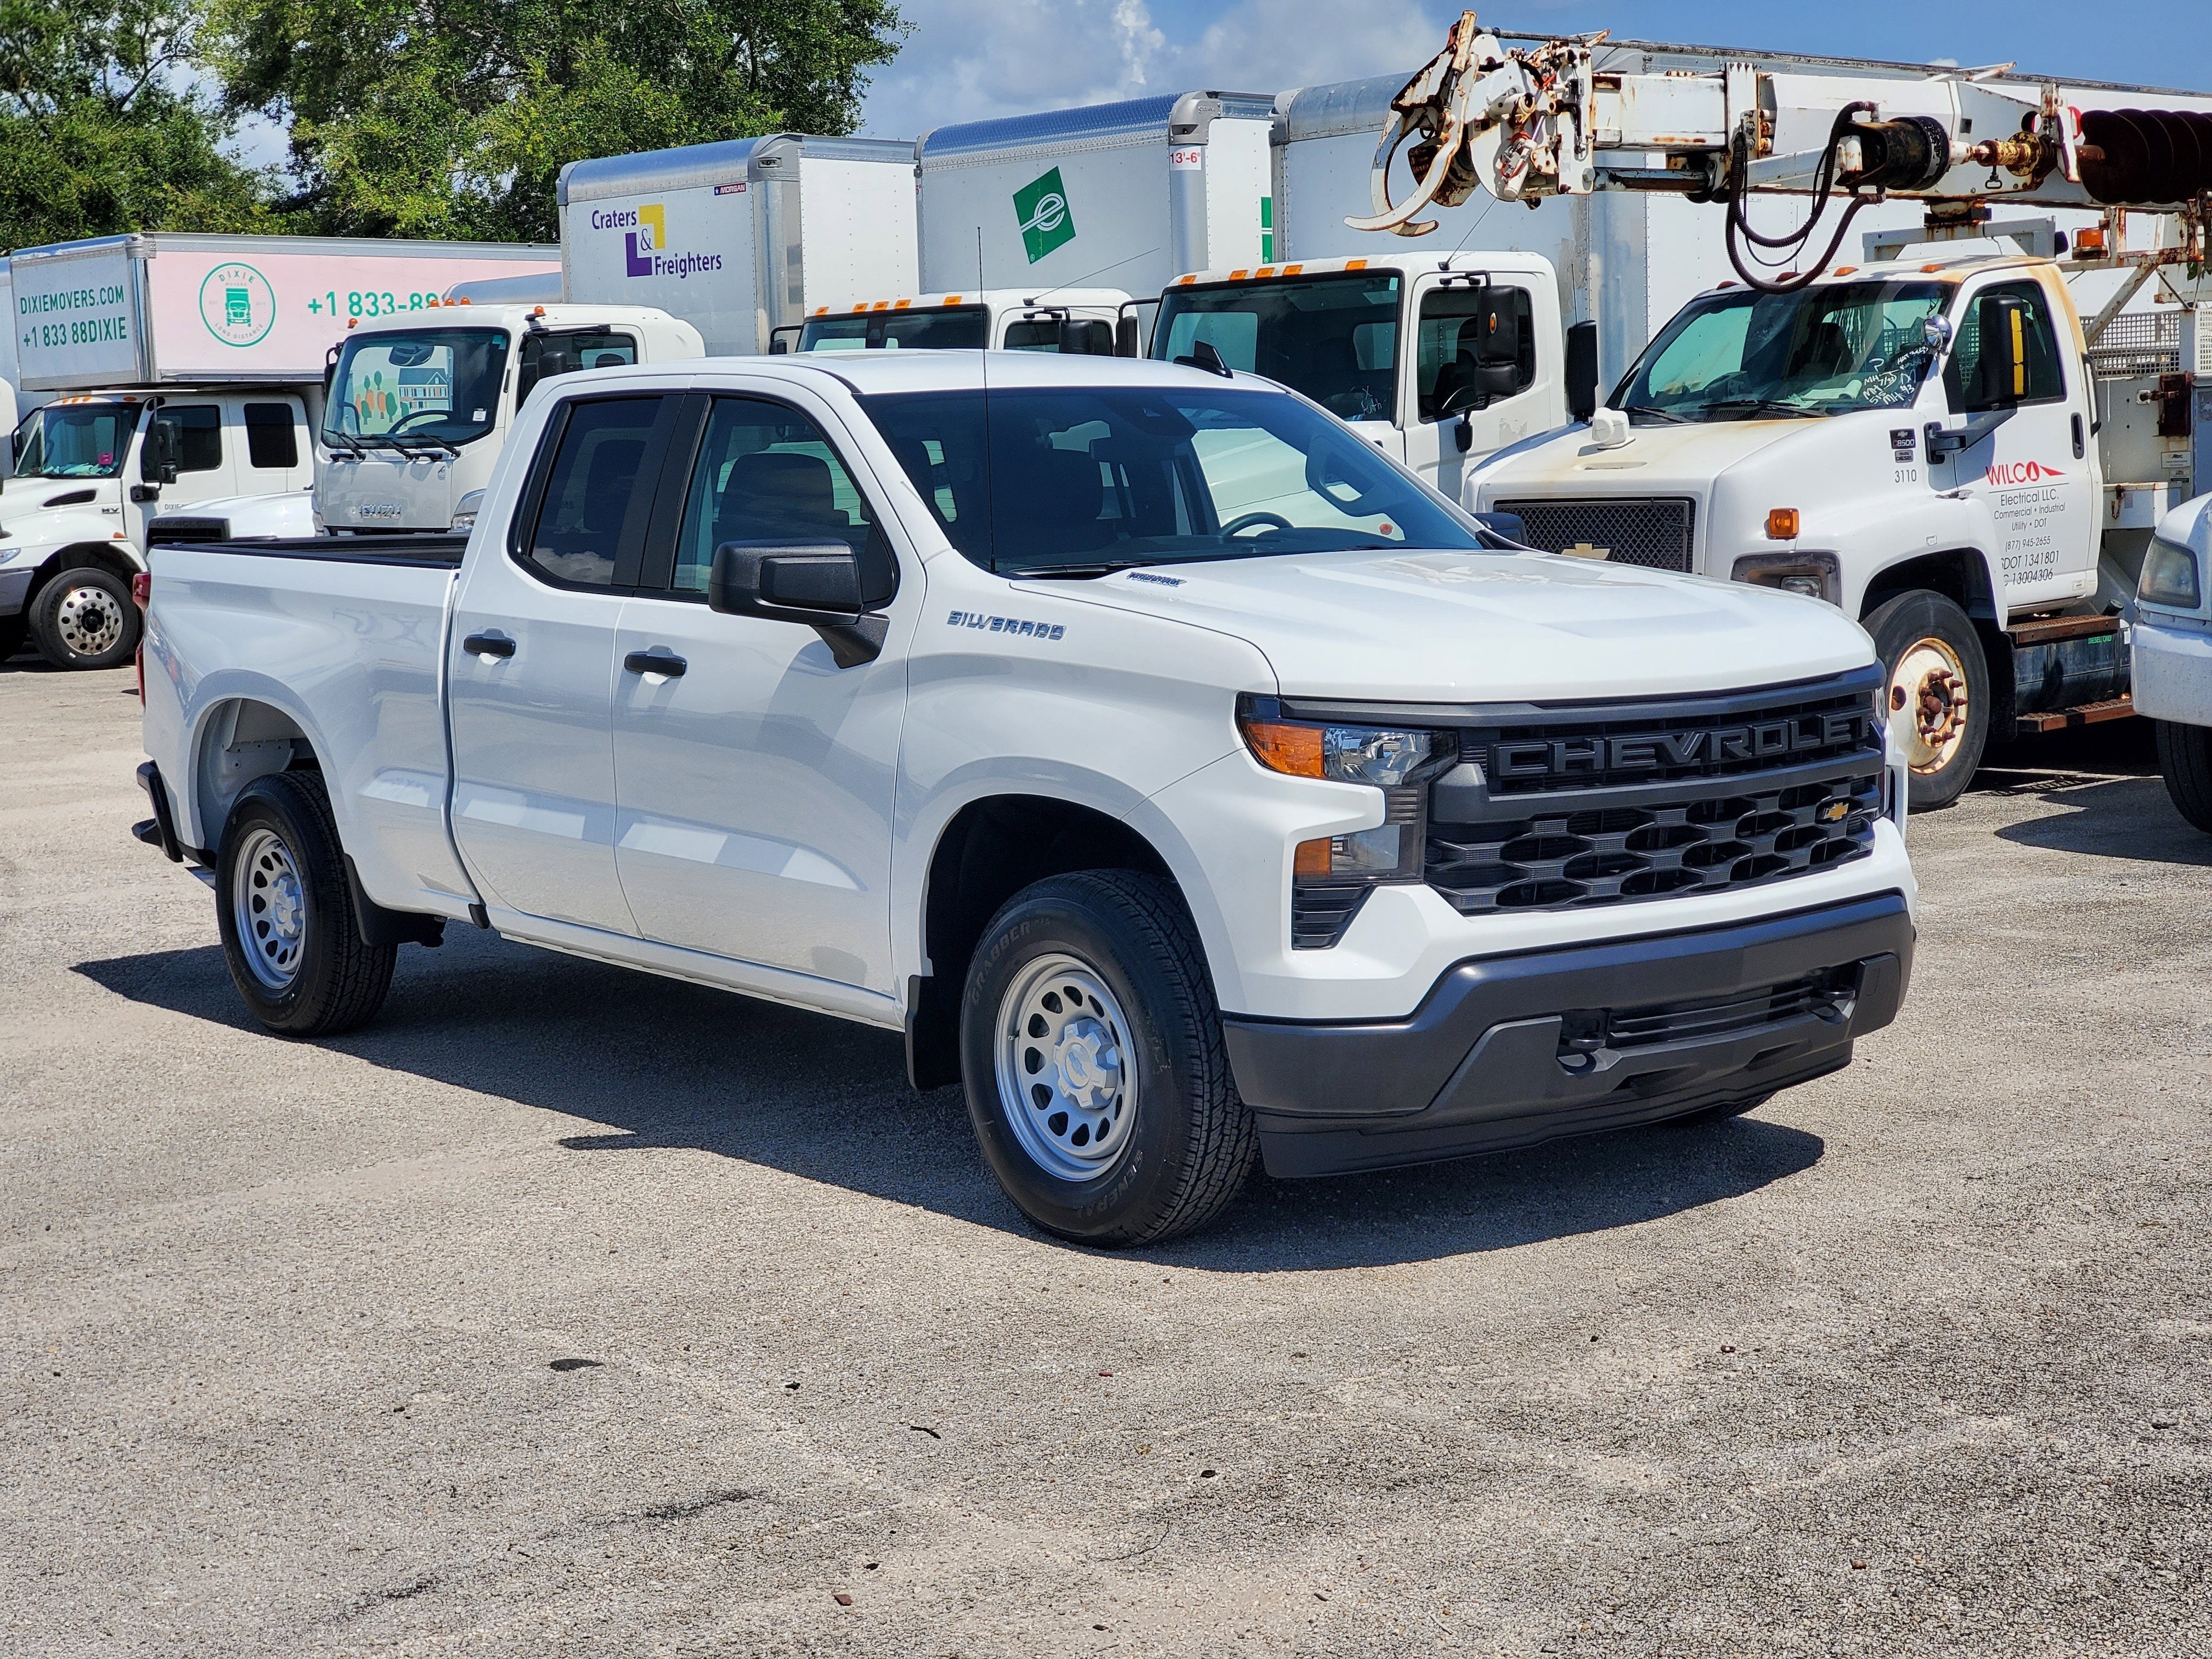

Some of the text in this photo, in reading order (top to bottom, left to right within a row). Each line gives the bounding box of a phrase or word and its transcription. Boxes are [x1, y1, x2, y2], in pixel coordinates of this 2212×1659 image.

[1170, 152, 1201, 164] 13'-6"
[720, 184, 746, 194] MORGAN
[591, 210, 637, 230] Craters
[640, 228, 653, 251] &
[654, 251, 722, 279] Freighters
[218, 270, 256, 284] DIXIE
[20, 285, 125, 314] DIXIEMOVERS.COM
[308, 291, 336, 317] +1
[24, 317, 127, 348] +1 833 88DIXIE
[215, 323, 264, 339] LONG DISTANCE
[1894, 469, 1917, 483] 3110
[1985, 460, 2040, 486] WILCO
[2000, 488, 2059, 506] Electrical LLC.
[359, 504, 402, 520] ISUZU
[1994, 502, 2066, 520] Commercial Industrial
[2011, 517, 2047, 532] Utility DOT
[2005, 535, 2051, 552] (877) 945-2655
[2025, 550, 2059, 567] 1341801
[2012, 568, 2053, 585] 13004306
[946, 610, 1068, 641] SILVERADO
[1492, 709, 1872, 777] CHEVROLET
